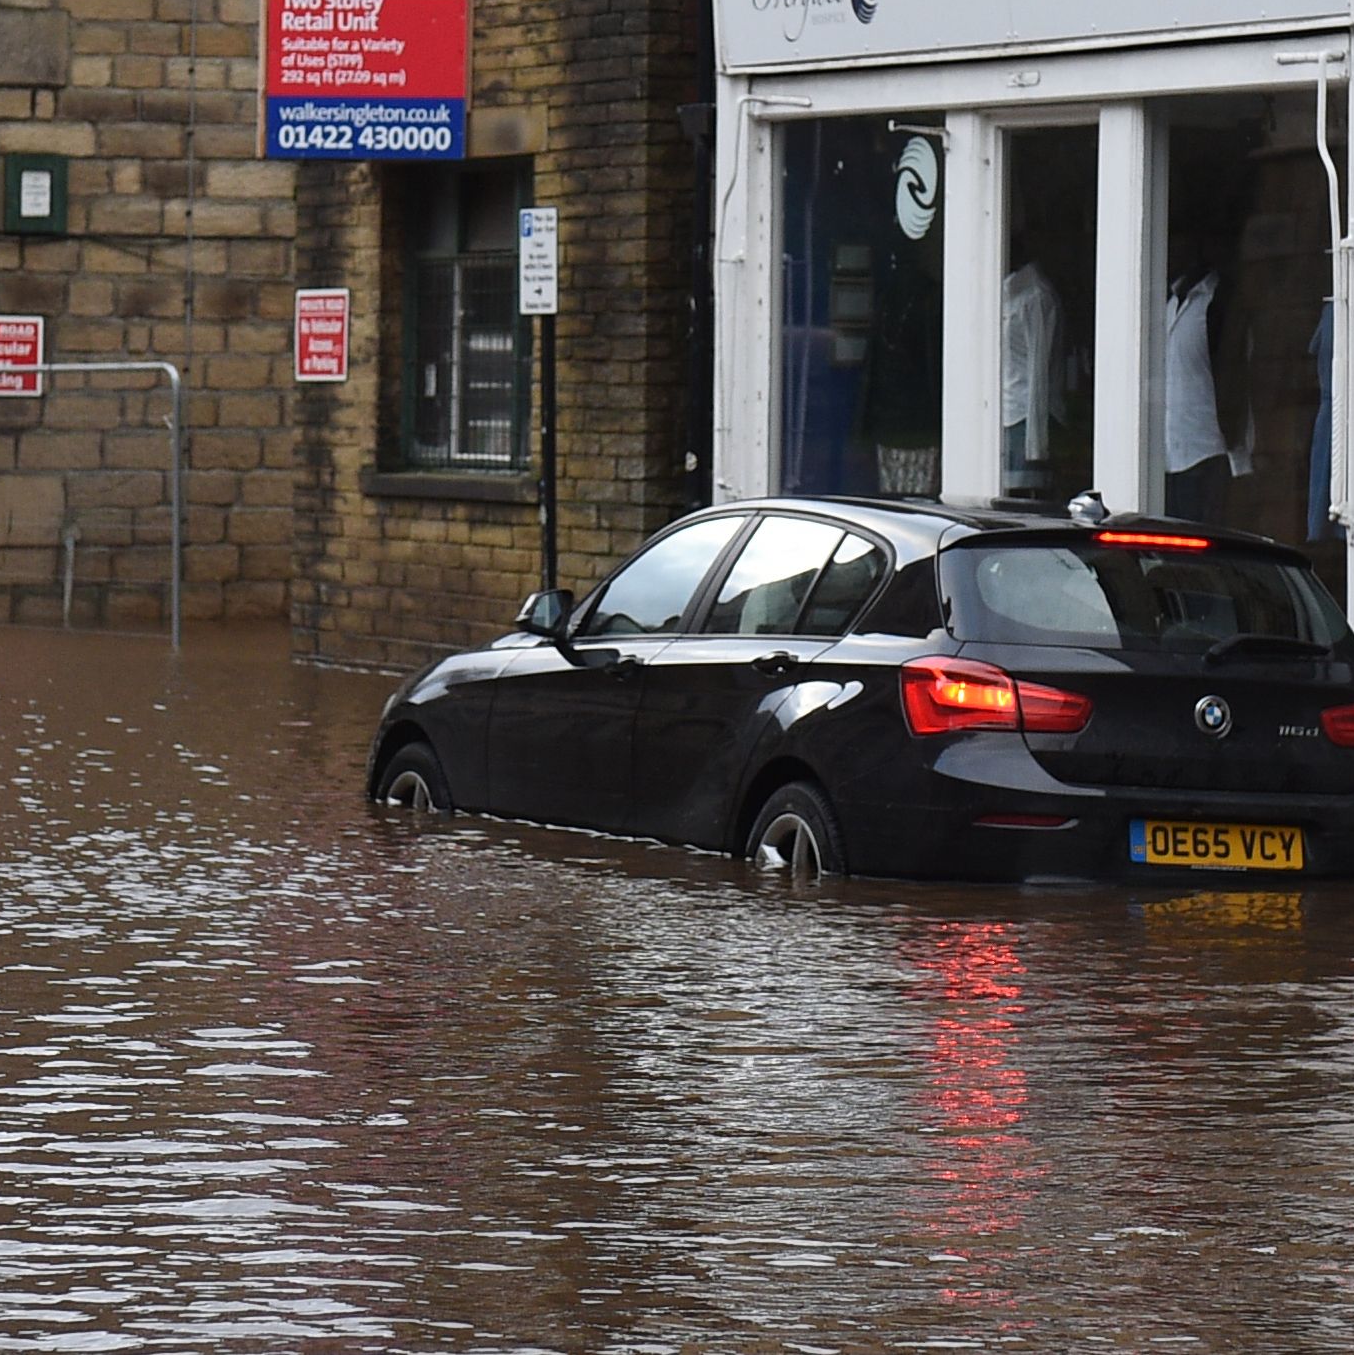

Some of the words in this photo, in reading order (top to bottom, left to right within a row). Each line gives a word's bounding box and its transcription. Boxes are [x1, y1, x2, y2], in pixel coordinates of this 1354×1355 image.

[282, 12, 333, 32] Retail
[338, 13, 378, 32] Unit
[282, 37, 327, 52] Suitable
[331, 37, 350, 52] for
[351, 41, 359, 52] a
[362, 39, 405, 55] Variety
[282, 54, 295, 67] of
[297, 55, 325, 67] Uses
[328, 54, 363, 69] (STPP)
[306, 73, 321, 87] sq
[323, 70, 333, 83] ft
[373, 73, 387, 87] sq
[389, 71, 406, 86] m)
[280, 103, 451, 126] walkersingleton.co.uk
[279, 126, 352, 148] 01422
[359, 126, 451, 150] 430000
[0, 324, 34, 336] ROAD
[1278, 724, 1319, 737] 116d
[1151, 825, 1231, 859] OE65
[1240, 829, 1296, 862] VCY
